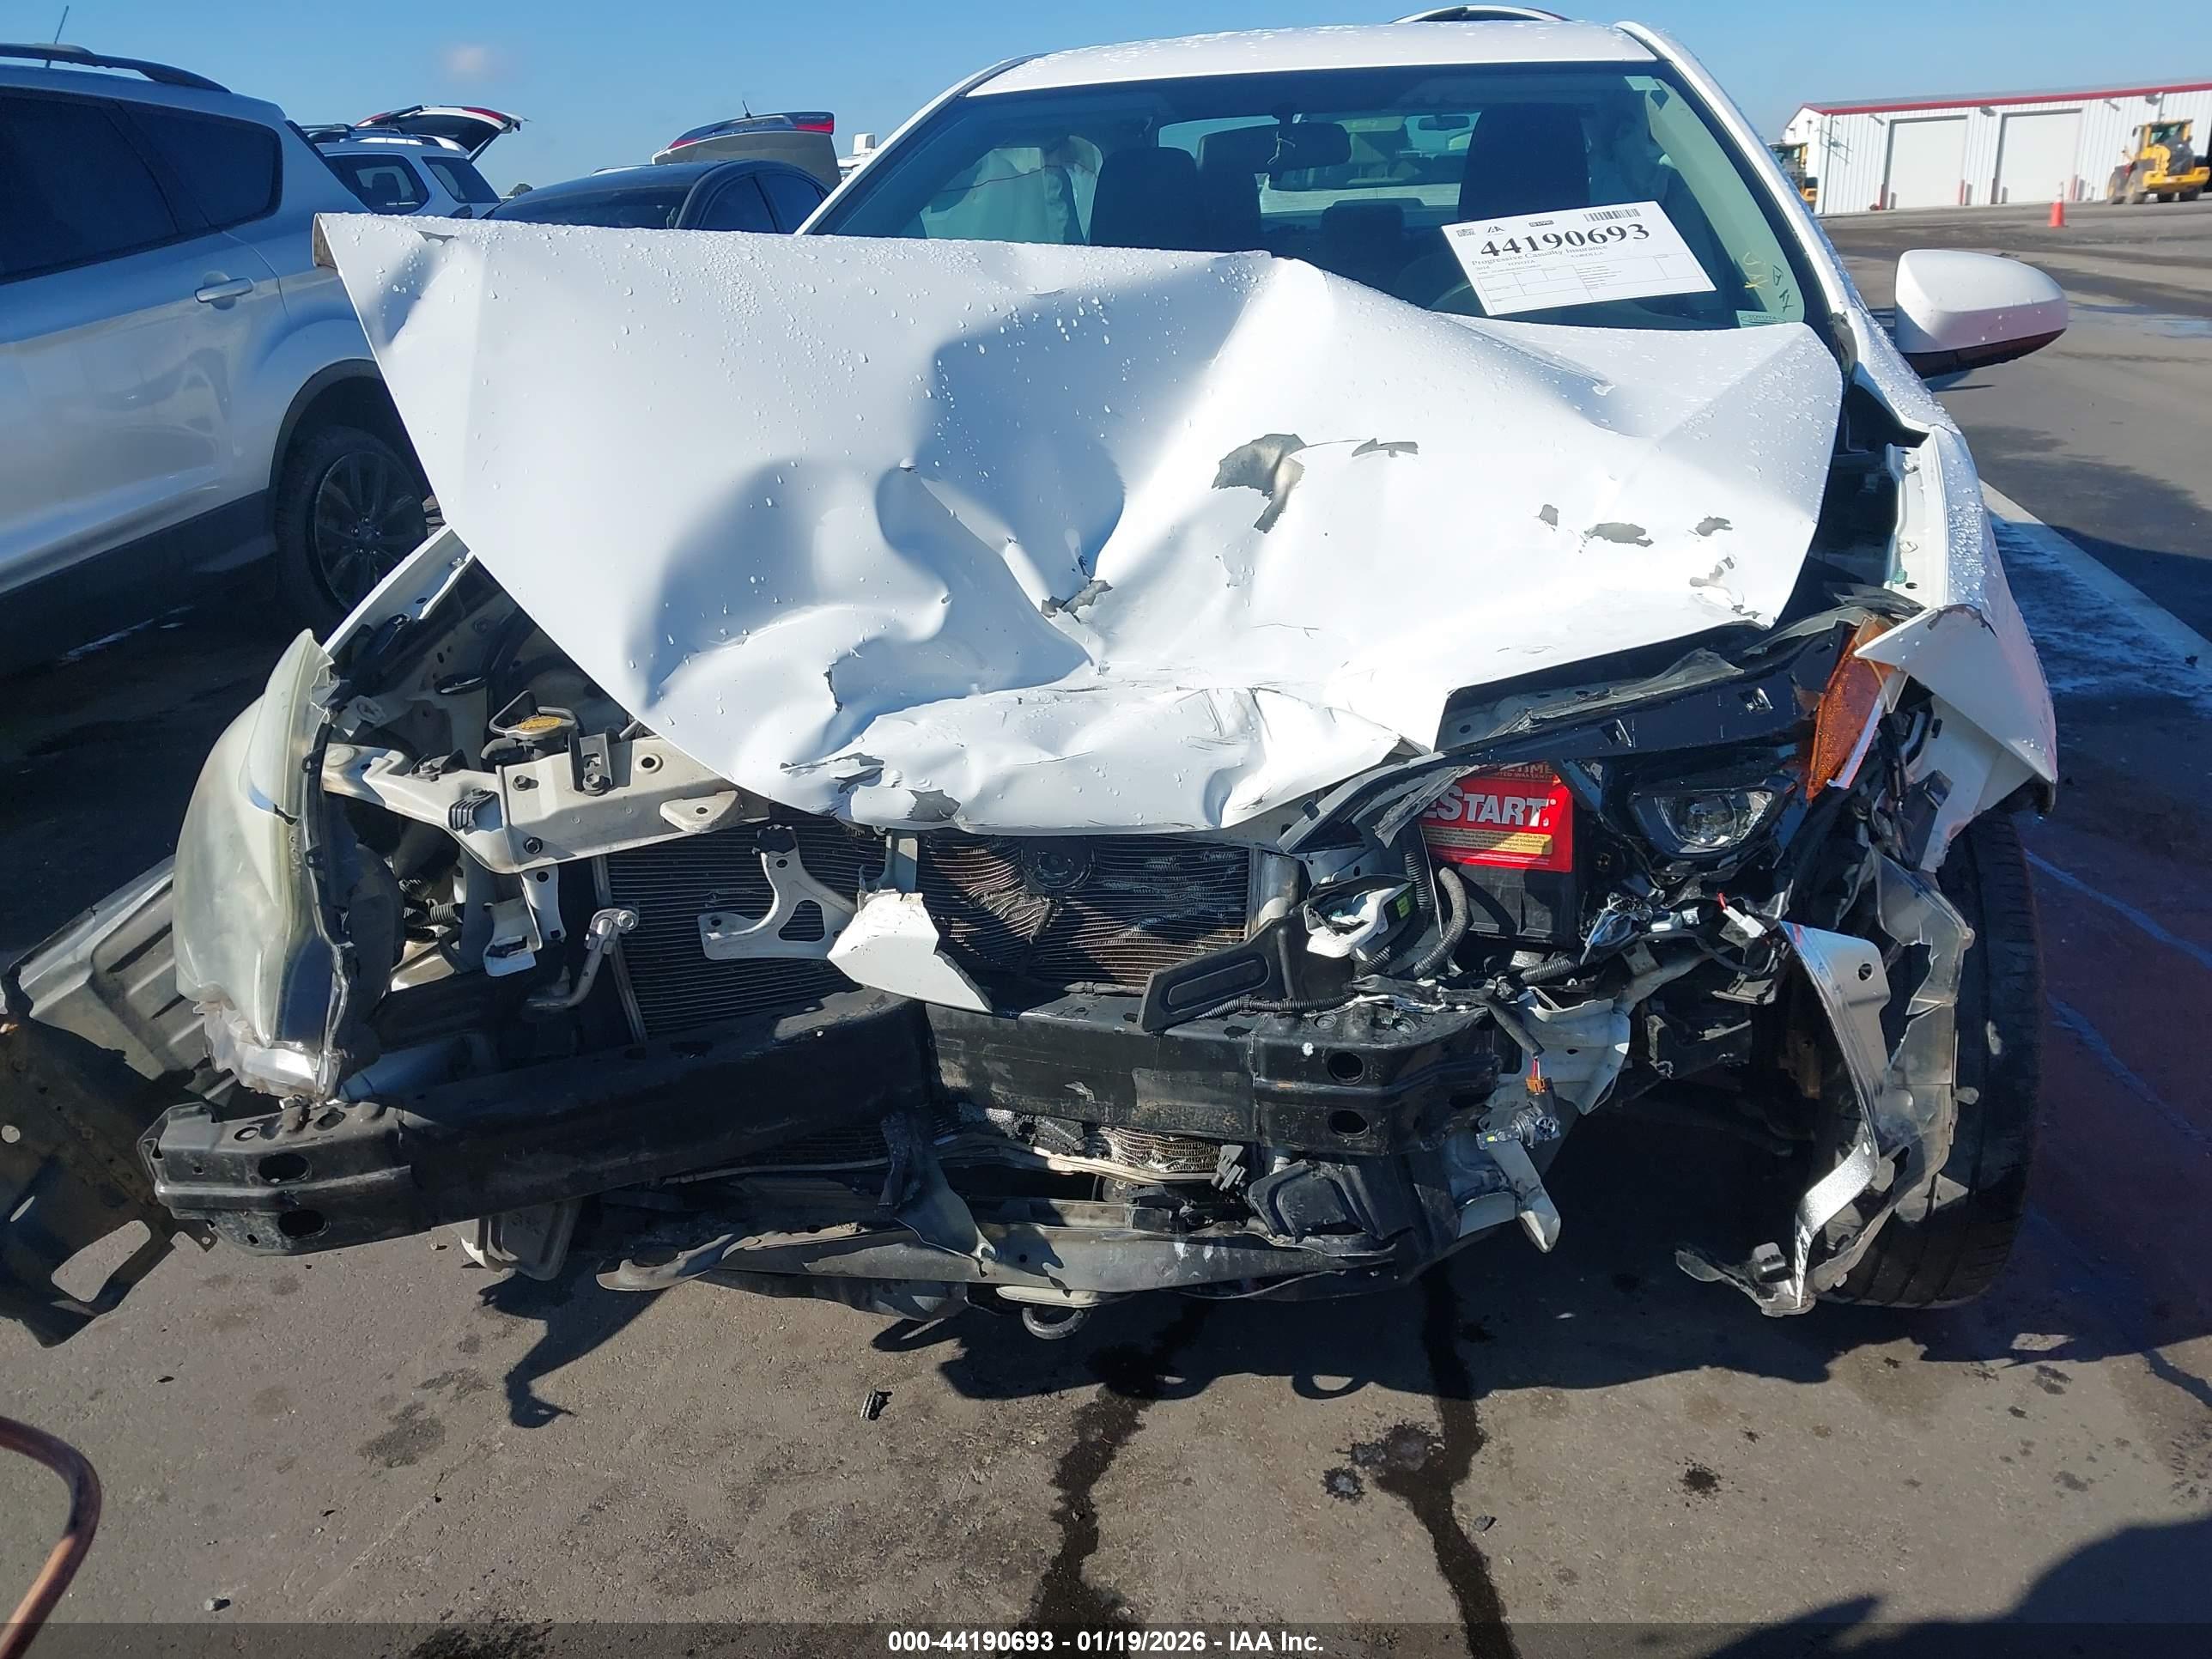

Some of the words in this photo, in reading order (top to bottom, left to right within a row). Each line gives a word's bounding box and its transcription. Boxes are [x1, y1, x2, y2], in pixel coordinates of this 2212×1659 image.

[1480, 223, 1650, 257] 44190693
[1471, 254, 1524, 267] Progressive
[1524, 249, 1563, 260] Casualty
[1565, 245, 1608, 254] Insurance
